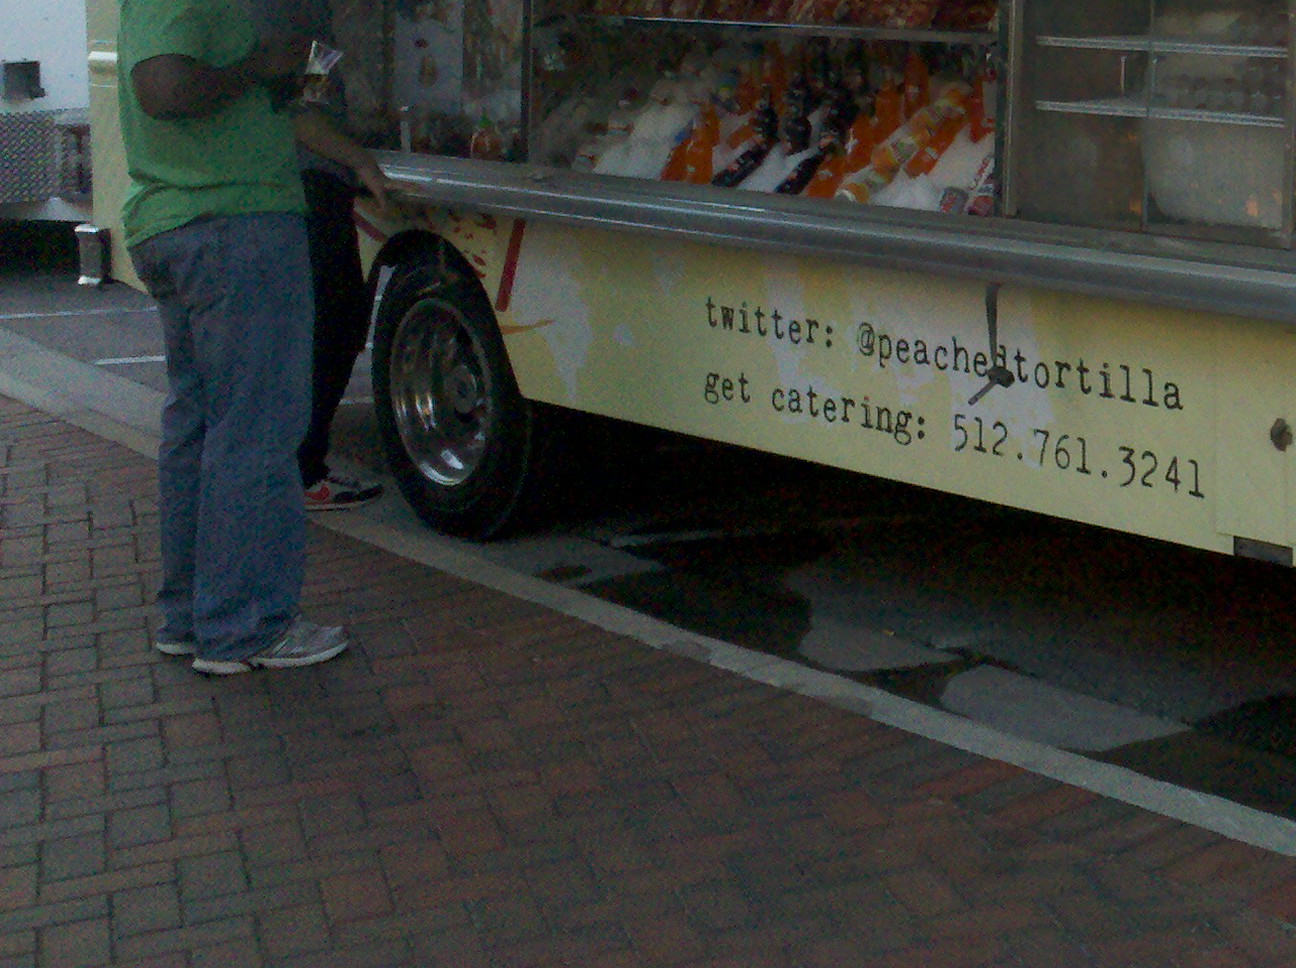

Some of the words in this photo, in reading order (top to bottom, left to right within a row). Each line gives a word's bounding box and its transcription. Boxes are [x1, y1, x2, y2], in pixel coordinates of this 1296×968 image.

[704, 295, 834, 350] twitter:
[703, 370, 751, 405] get
[770, 382, 927, 446] catering:
[953, 412, 1206, 500] 512.761.3241
